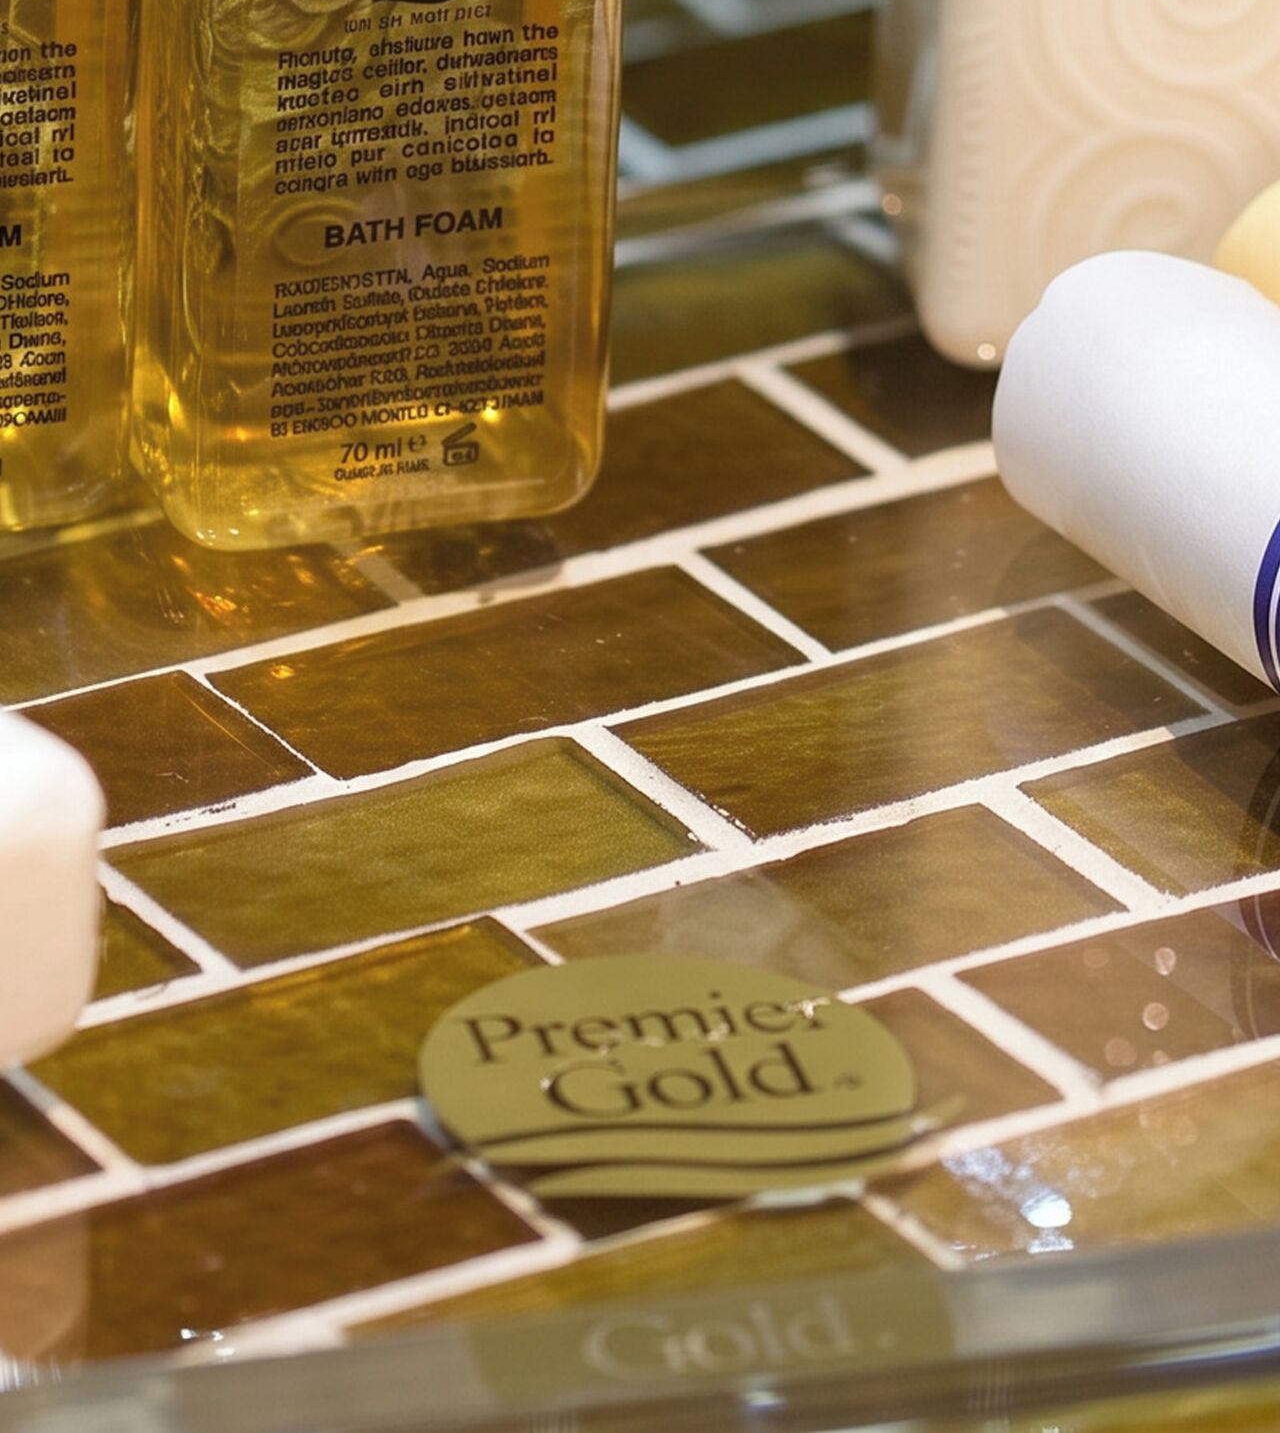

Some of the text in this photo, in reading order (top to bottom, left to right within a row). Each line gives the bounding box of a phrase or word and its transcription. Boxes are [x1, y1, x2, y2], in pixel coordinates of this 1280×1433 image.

[324, 207, 503, 249] BATH FOAM
[340, 437, 402, 464] 70 ml
[462, 990, 829, 1064] Premier
